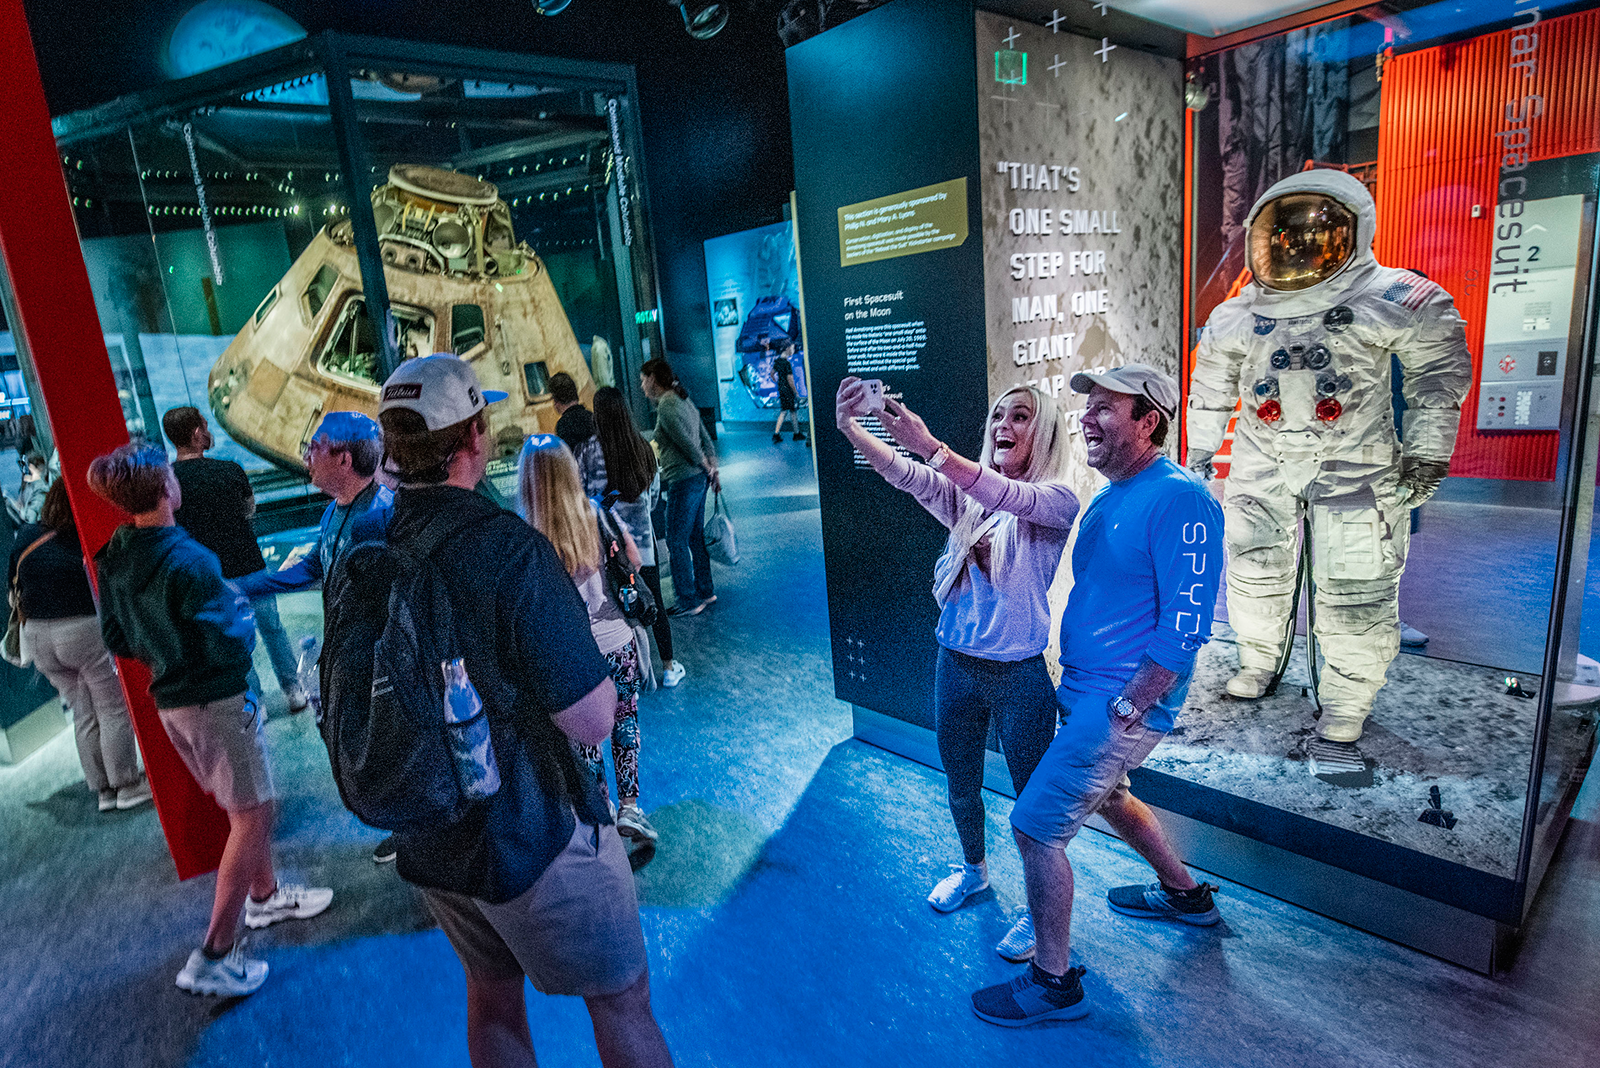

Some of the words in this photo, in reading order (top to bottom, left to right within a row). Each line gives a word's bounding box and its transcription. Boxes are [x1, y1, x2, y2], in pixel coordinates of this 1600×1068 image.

[997, 161, 1080, 192] "THAT'S
[1492, 94, 1544, 294] Spacesuit
[1009, 207, 1053, 235] ONE
[1059, 209, 1122, 235] SMALL
[1010, 252, 1063, 280] STEP
[1069, 250, 1107, 276] FOR
[1527, 246, 1540, 262] 2
[844, 296, 863, 307] First
[864, 290, 904, 306] Spacesuit
[1012, 294, 1064, 324] MAN,
[1072, 290, 1108, 317] ONE
[844, 312, 854, 320] on
[855, 309, 869, 319] the
[869, 307, 892, 317] Moon
[1011, 333, 1076, 367] GIANT
[1014, 374, 1065, 399] AP
